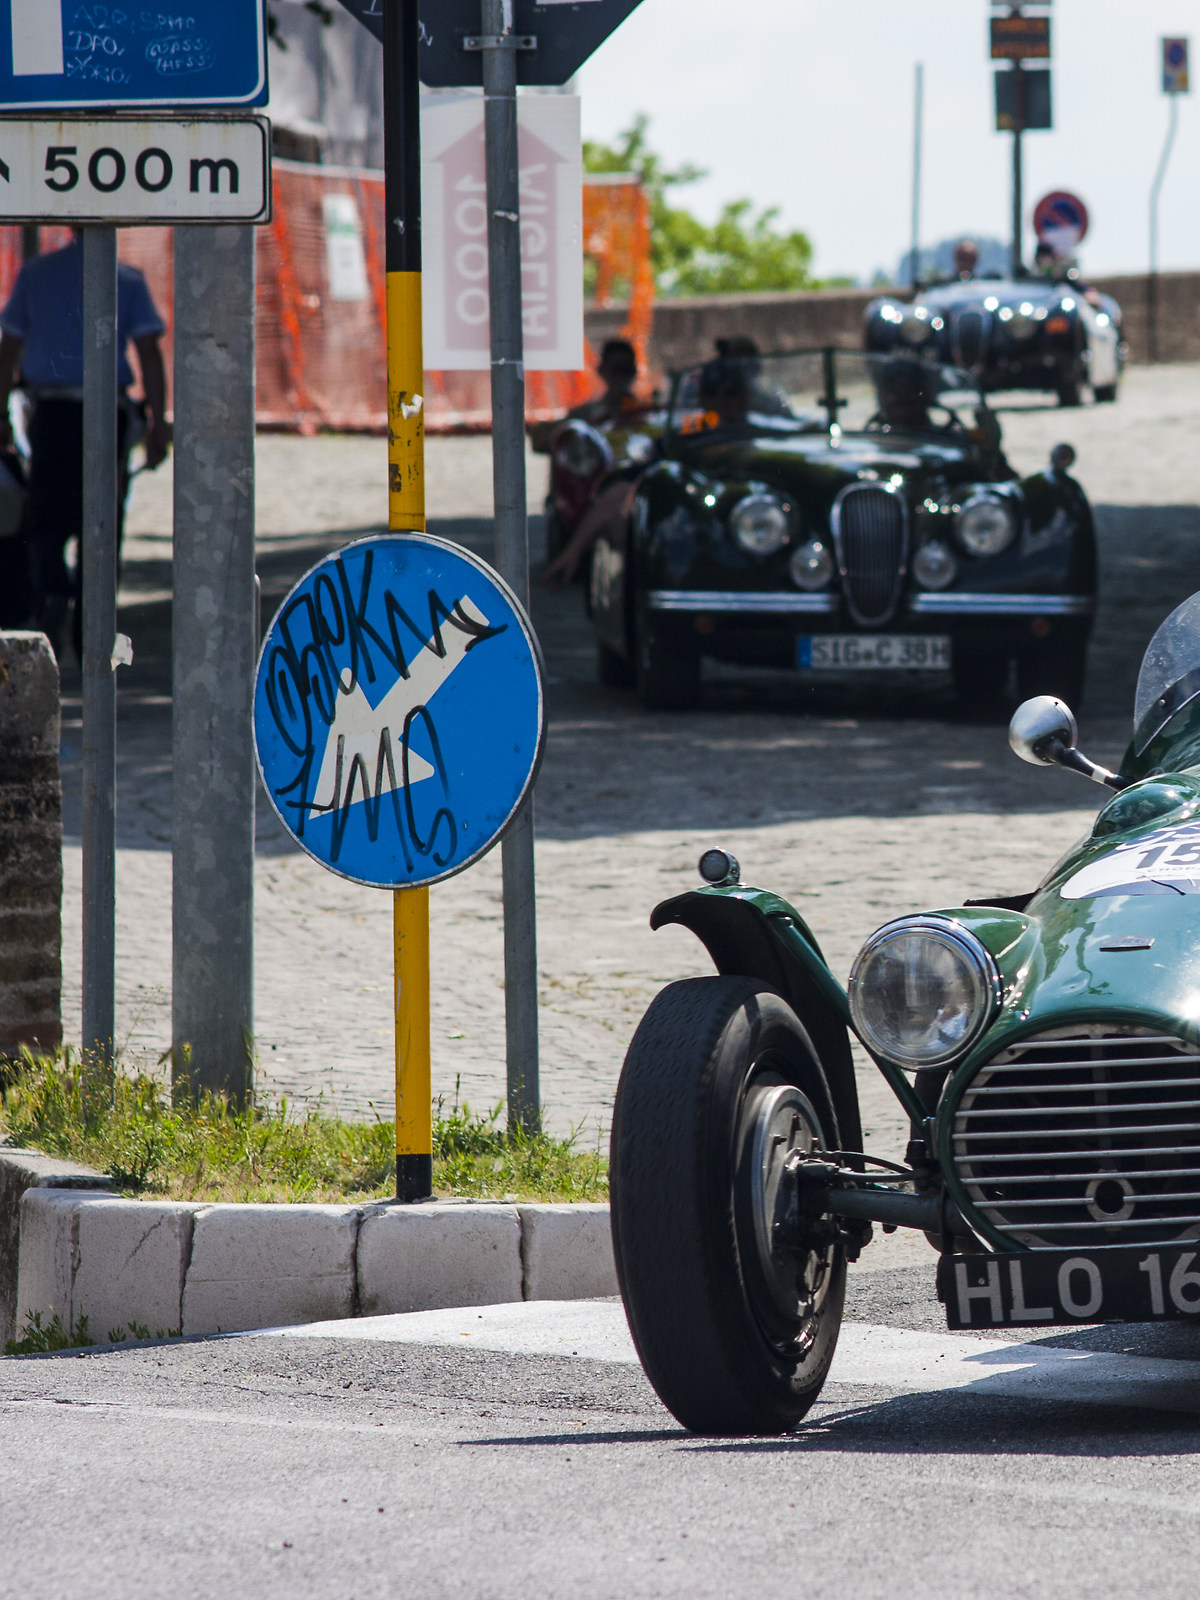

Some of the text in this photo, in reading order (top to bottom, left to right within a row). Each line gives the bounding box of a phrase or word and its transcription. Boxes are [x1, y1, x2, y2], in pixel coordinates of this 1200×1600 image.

[45, 147, 239, 193] 500 m
[955, 1257, 1103, 1323] HLO
